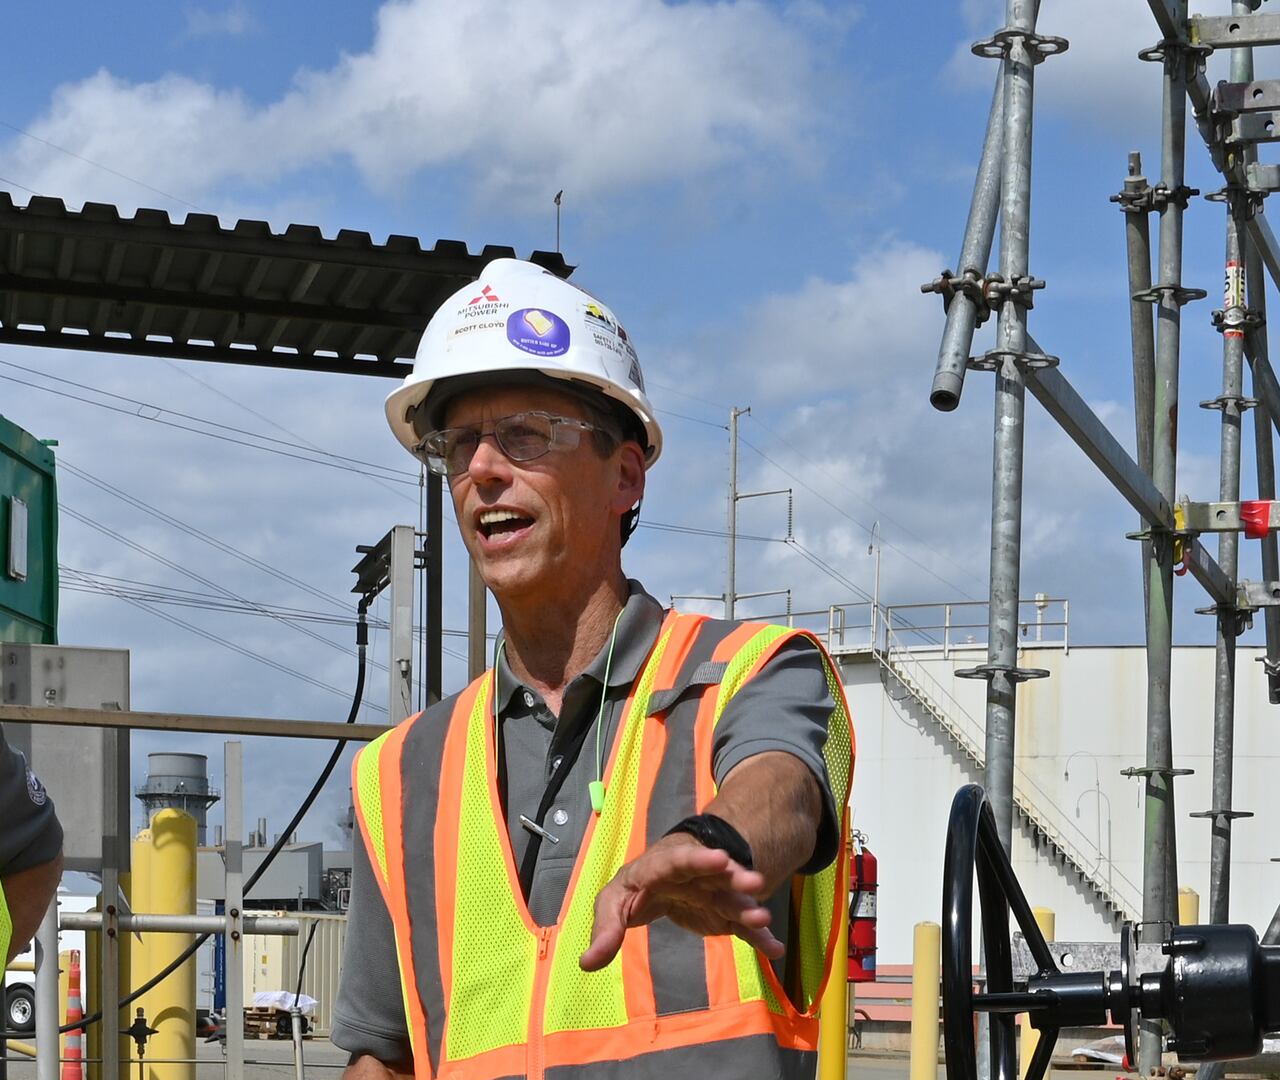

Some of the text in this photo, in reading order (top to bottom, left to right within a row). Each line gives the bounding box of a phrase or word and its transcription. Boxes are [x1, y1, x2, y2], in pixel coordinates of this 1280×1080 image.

[458, 303, 509, 316] MITSUBISHI
[465, 309, 497, 318] POWER
[455, 325, 477, 335] SCOTT
